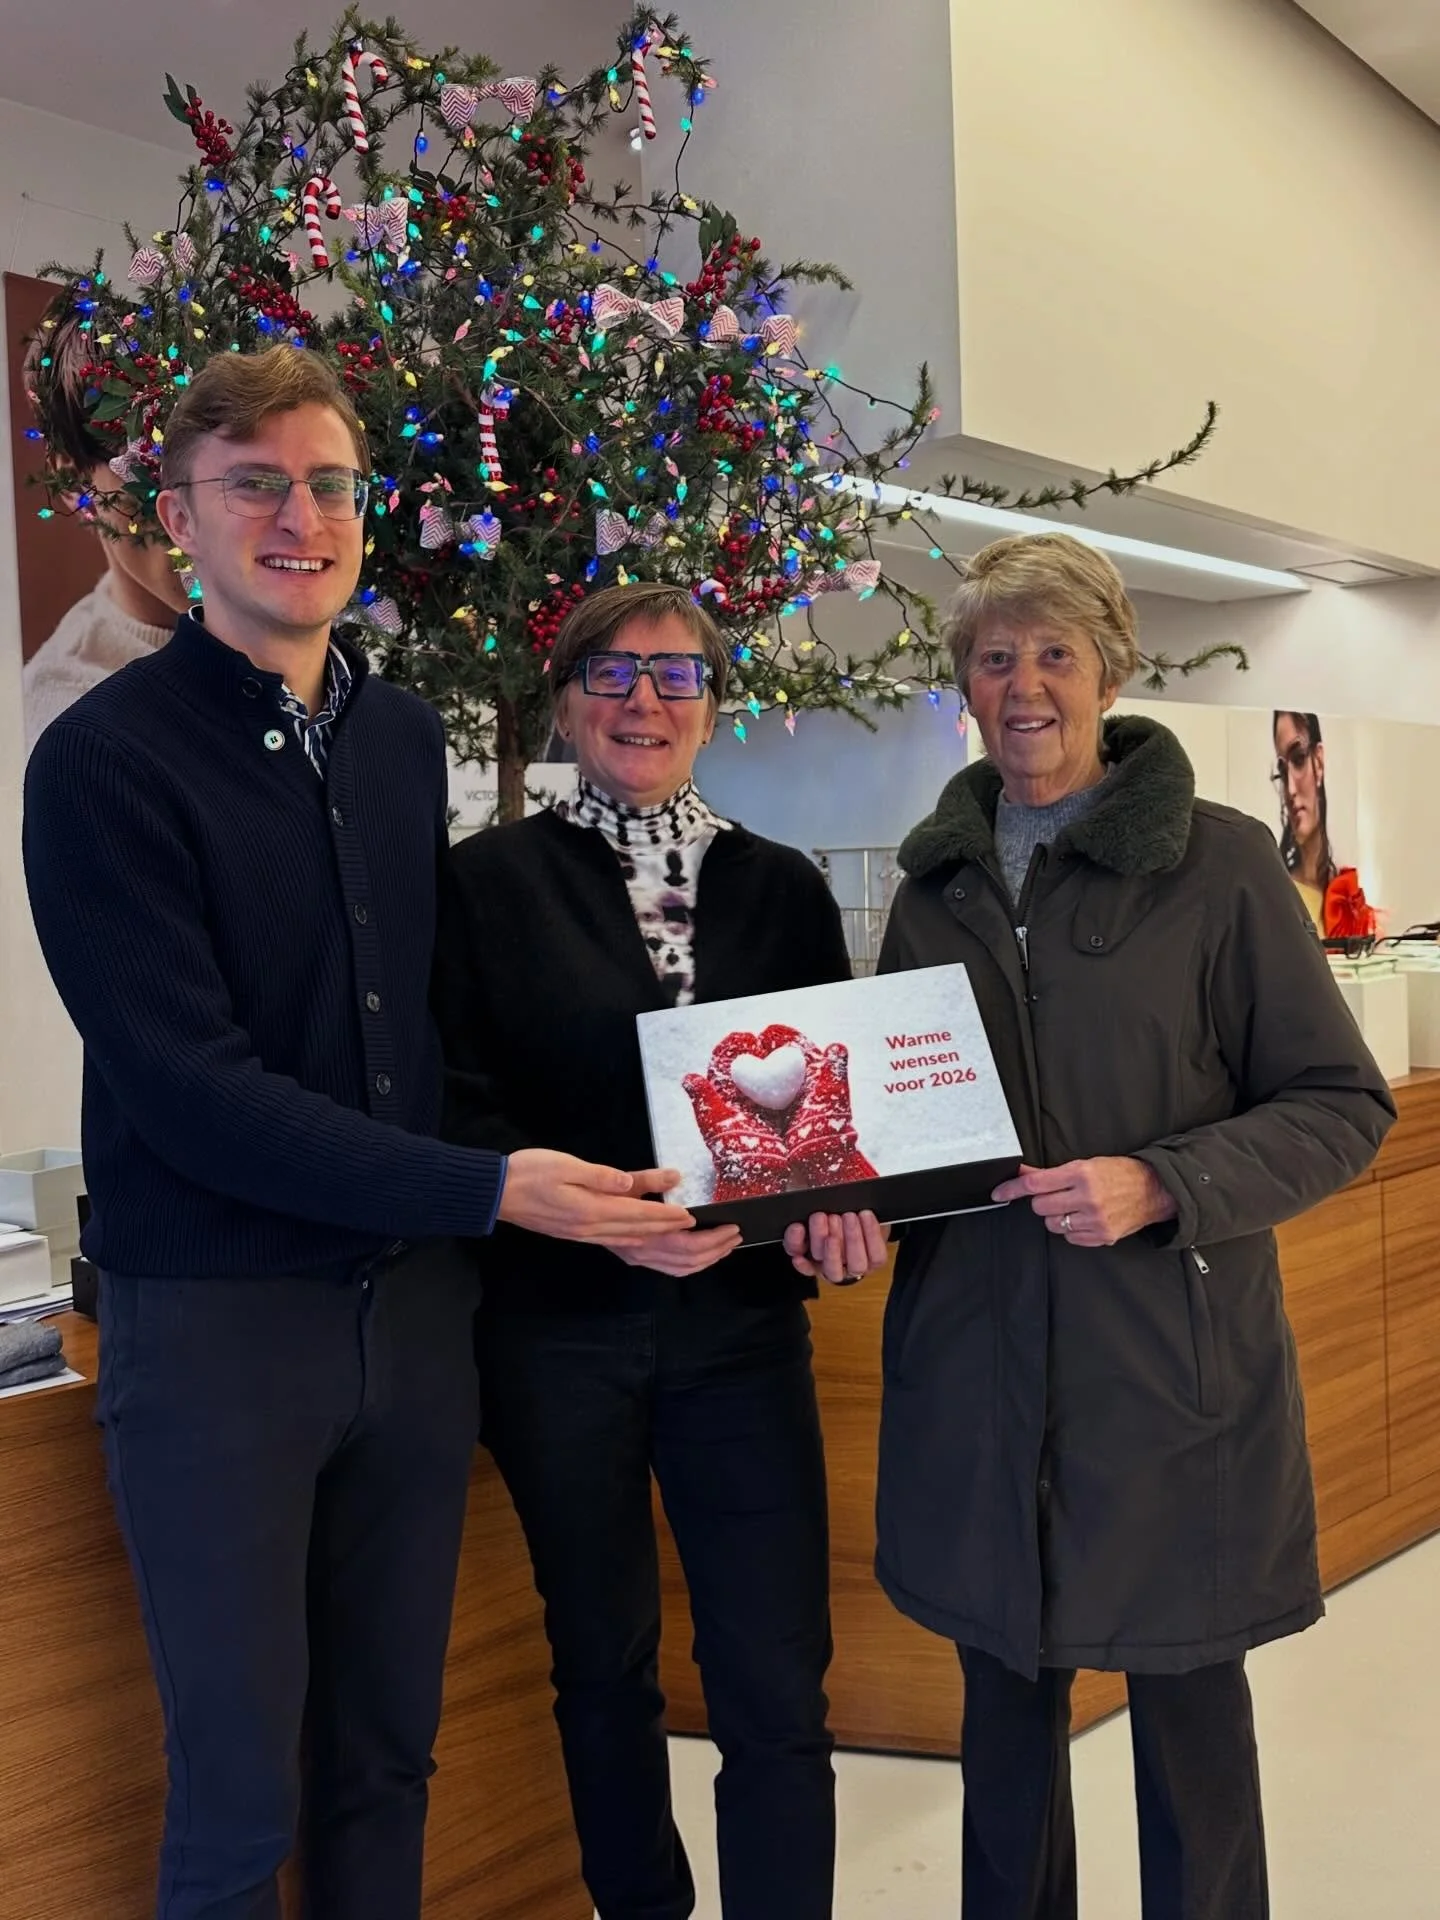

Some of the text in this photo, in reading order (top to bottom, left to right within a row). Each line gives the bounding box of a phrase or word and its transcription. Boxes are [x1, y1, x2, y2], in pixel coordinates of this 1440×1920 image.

[464, 790, 498, 801] VICTO
[886, 1031, 952, 1049] Warme
[890, 1051, 960, 1071] wensen
[884, 1067, 977, 1094] voor 2026
